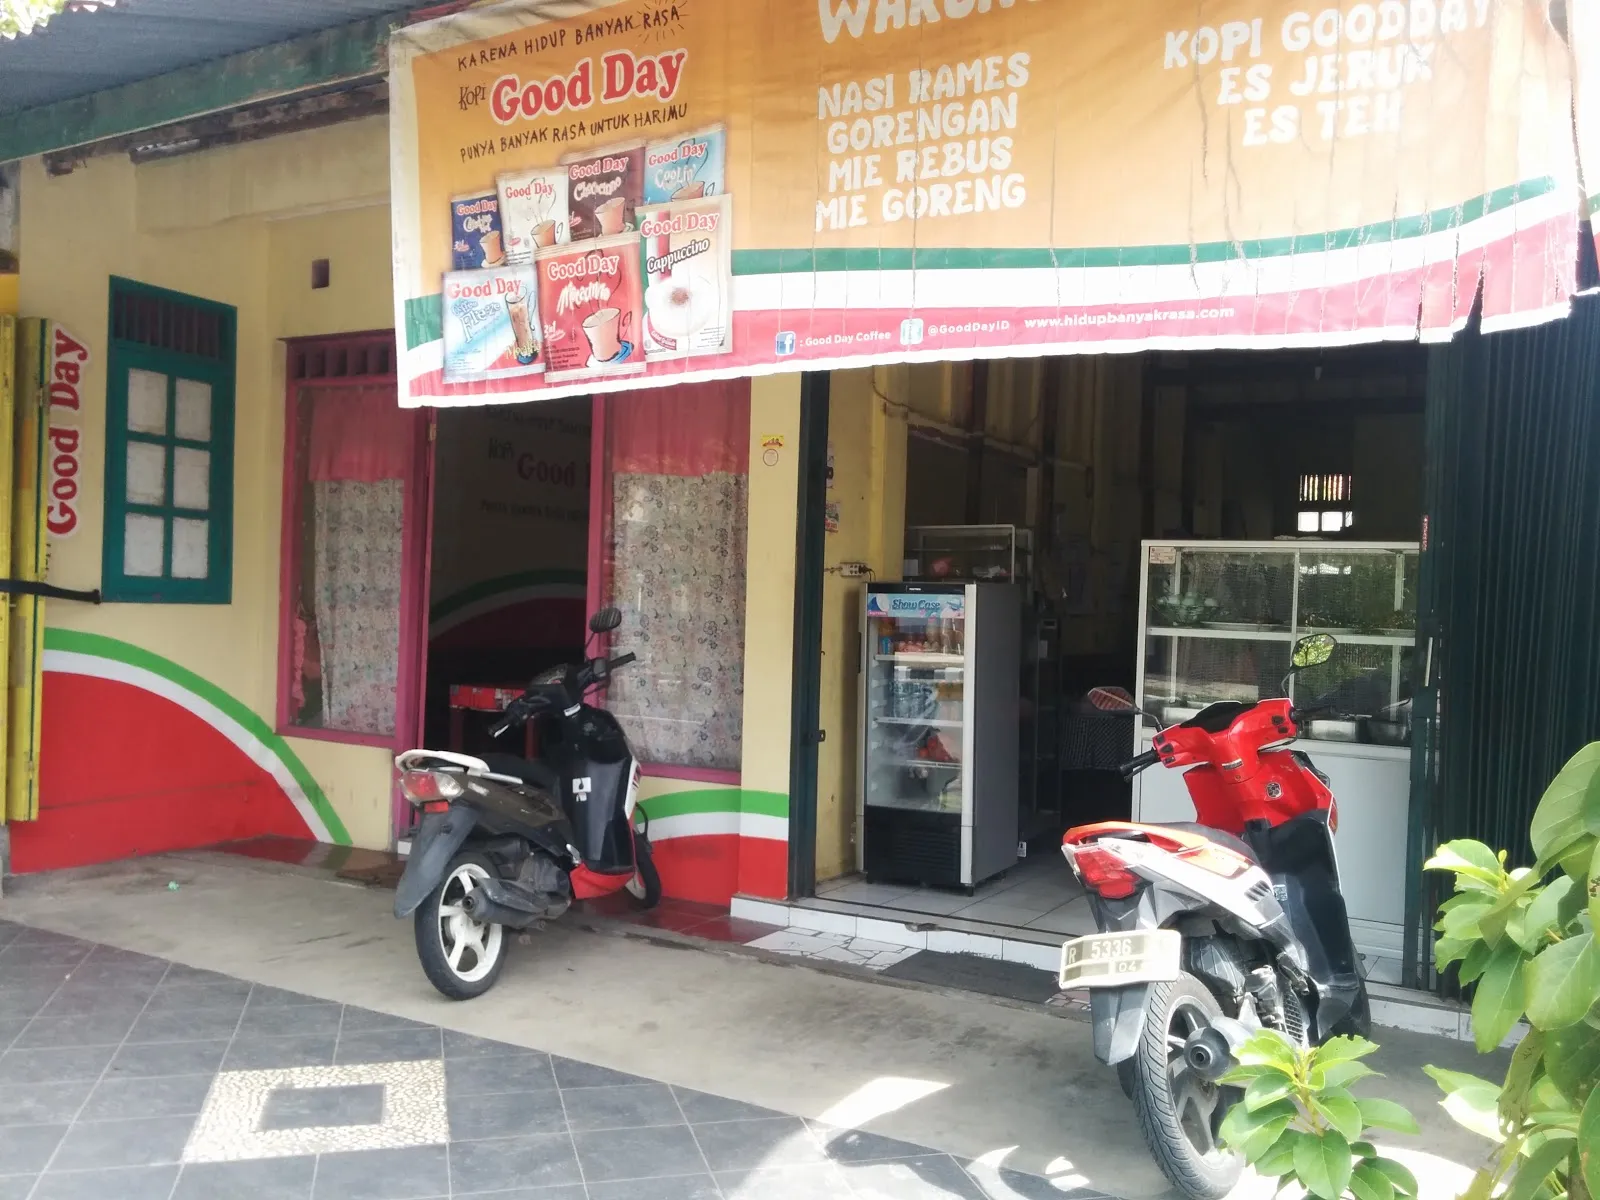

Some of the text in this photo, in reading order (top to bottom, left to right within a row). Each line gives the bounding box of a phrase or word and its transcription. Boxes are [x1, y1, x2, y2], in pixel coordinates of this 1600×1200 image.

[457, 5, 680, 71] KARENA HIDUP BANYAK RASA
[1163, 18, 1263, 69] KOPI
[491, 61, 592, 122] Good
[603, 51, 686, 101] Day
[817, 52, 1031, 119] NASI RAMES
[1217, 42, 1436, 105] ES JERUK
[460, 103, 688, 163] PUNYA BANYAK RASA UNTUK HARIMU
[827, 92, 1018, 154] GORENGAN
[1243, 93, 1401, 146] ES TEH
[570, 157, 629, 180] Good Day
[648, 142, 707, 166] Good Day
[829, 136, 1013, 192] MIE REBUS
[457, 200, 497, 215] Good Day
[505, 182, 554, 198] Good Day
[815, 173, 1026, 232] MIE GORENG
[641, 213, 719, 237] Good Day
[548, 255, 620, 280] Good Day
[647, 238, 710, 274] Cappuccino
[447, 277, 521, 299] Good Day
[805, 336, 832, 347] Good
[834, 333, 854, 345] Day
[856, 330, 891, 342] Coffee
[1024, 308, 1235, 329] www.hidupbanyakrasa.com
[47, 329, 88, 534] Good Day
[892, 598, 940, 611] Show Case
[1091, 938, 1132, 959] 5336
